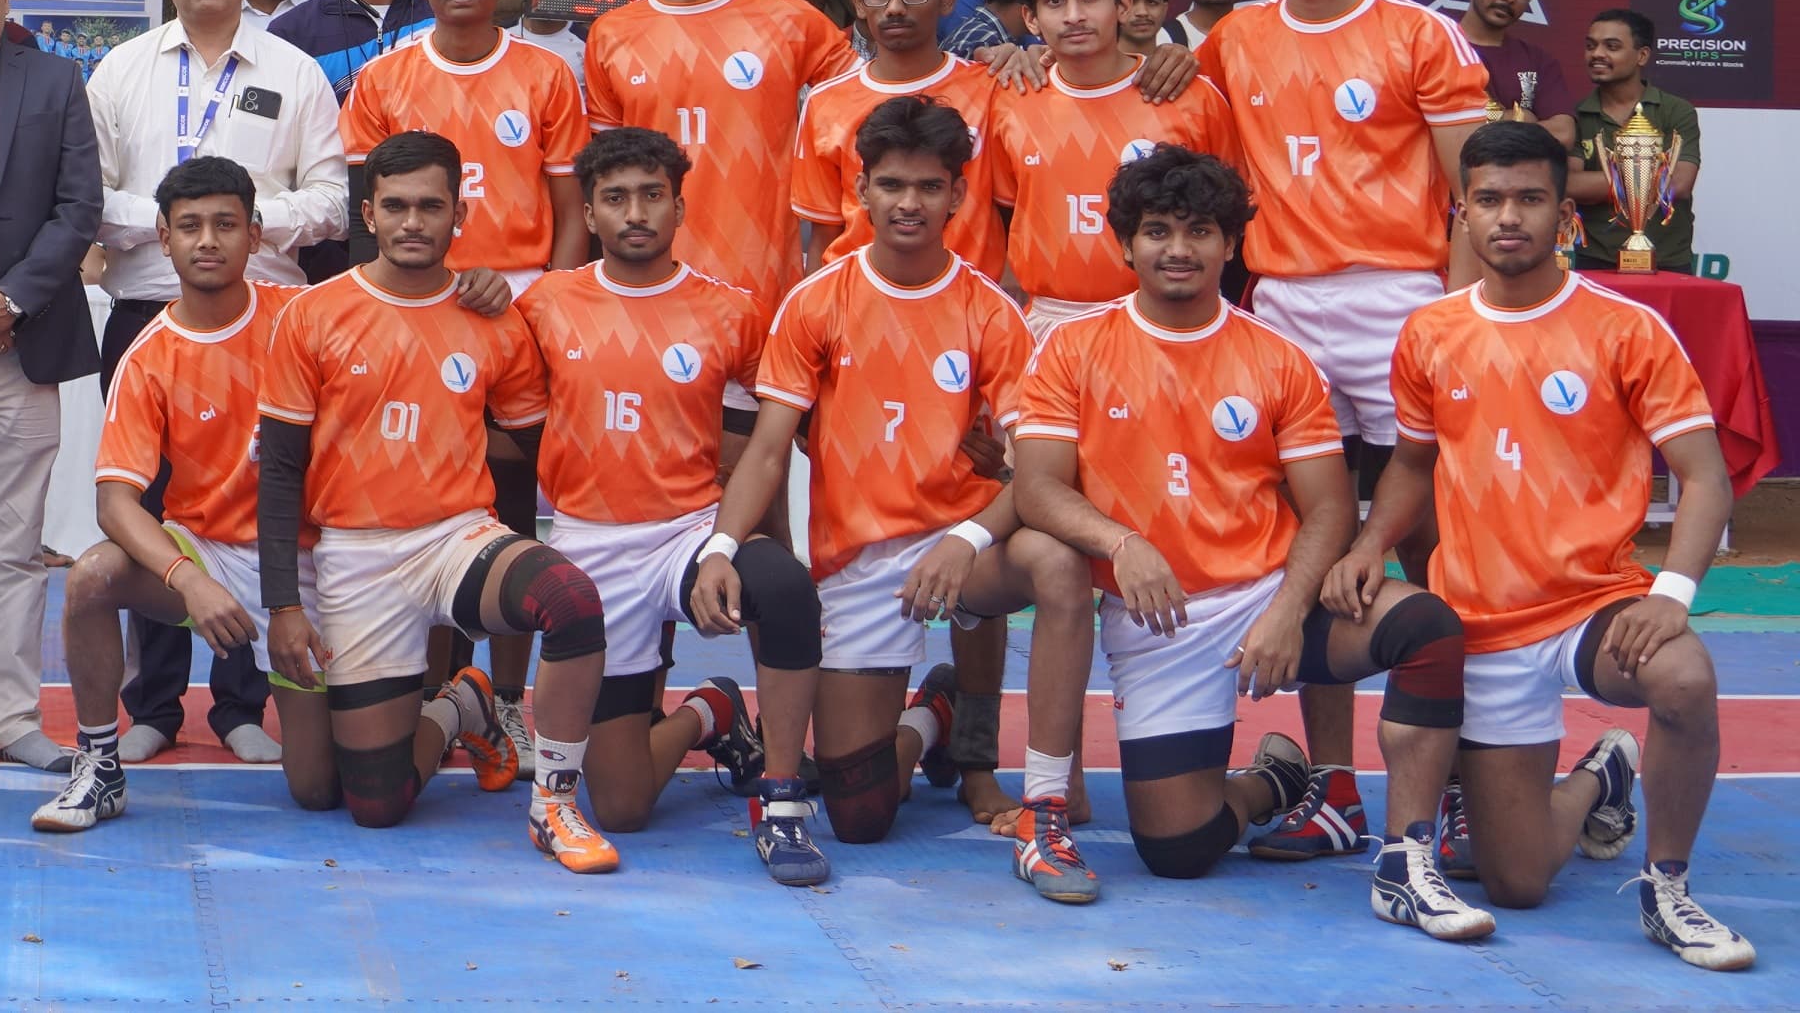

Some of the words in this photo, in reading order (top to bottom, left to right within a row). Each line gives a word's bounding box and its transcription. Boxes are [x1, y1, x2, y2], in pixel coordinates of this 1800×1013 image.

[1657, 38, 1746, 51] PRECISION
[1684, 51, 1719, 59] PIPS
[677, 107, 707, 145] 11
[1285, 135, 1321, 176] 17
[1066, 194, 1104, 235] 15
[380, 401, 420, 444] 01
[604, 391, 643, 432] 16
[883, 401, 905, 443] 7
[1496, 428, 1521, 471] 4
[1167, 453, 1190, 496] 3
